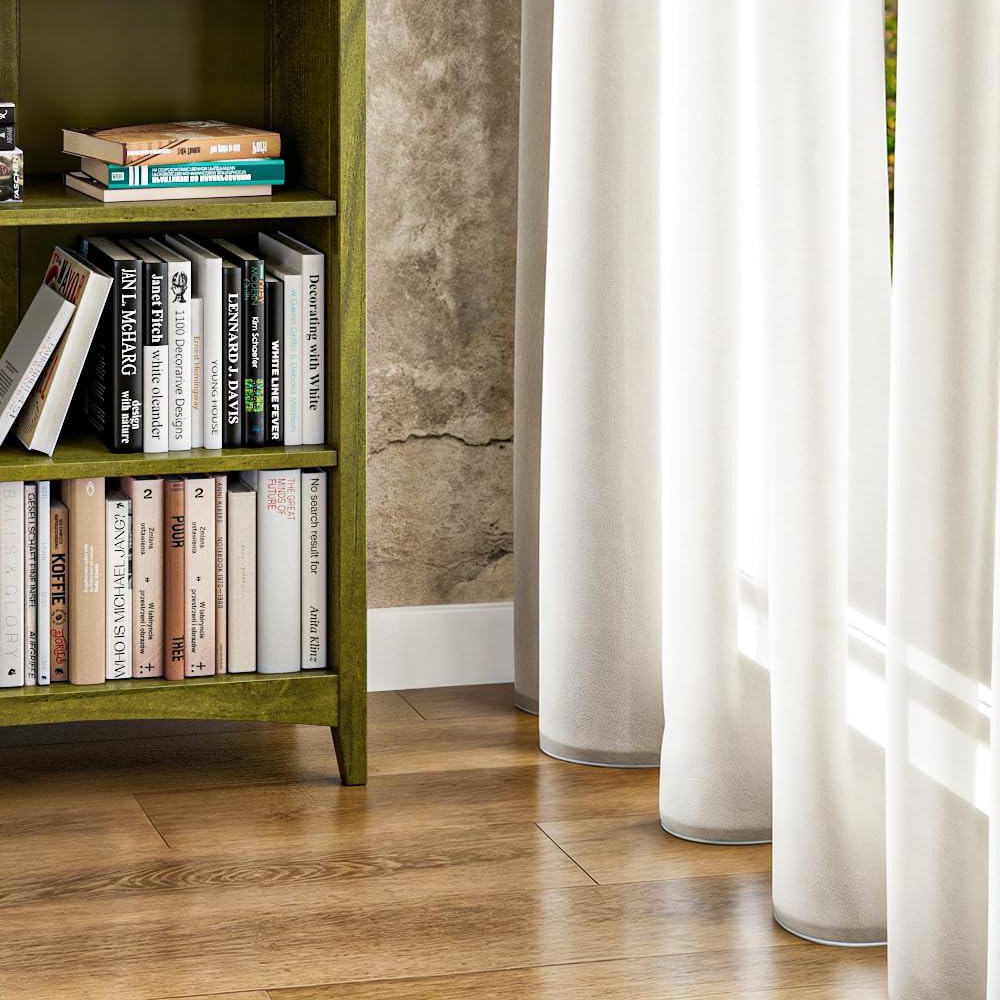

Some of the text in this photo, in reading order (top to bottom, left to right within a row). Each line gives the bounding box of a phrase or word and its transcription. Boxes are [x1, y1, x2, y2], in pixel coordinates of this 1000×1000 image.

[12, 155, 20, 200] TASCHEN
[121, 268, 137, 376] JAN L. McHARG
[151, 274, 164, 343] Janet Fitch
[175, 310, 185, 336] 1100
[228, 293, 239, 425] LENNARD J. DAVIS
[251, 316, 259, 368] Kim Schaefer
[307, 274, 320, 411] Decorating with White
[152, 350, 164, 441] white oleander
[192, 362, 201, 410] Hemingway
[211, 360, 219, 436] YOUNG HOUSE
[271, 340, 280, 440] WHITE LINE FEVER
[121, 390, 132, 444] with nature
[130, 399, 142, 430] design
[172, 398, 186, 440] Designs
[143, 488, 153, 499] 2
[194, 487, 204, 498] 2
[267, 478, 277, 510] FUTURE
[277, 478, 286, 516] MINDS OF
[287, 477, 296, 520] THE GREAT
[171, 516, 185, 548] PUUR
[310, 478, 320, 575] No search result for
[51, 553, 66, 605] KOFFIE
[113, 514, 126, 678] WHO IS MICHAEL JANG?
[4, 584, 19, 658] GLORY
[309, 606, 320, 663] Anita Klinz
[171, 634, 185, 662] THEE
